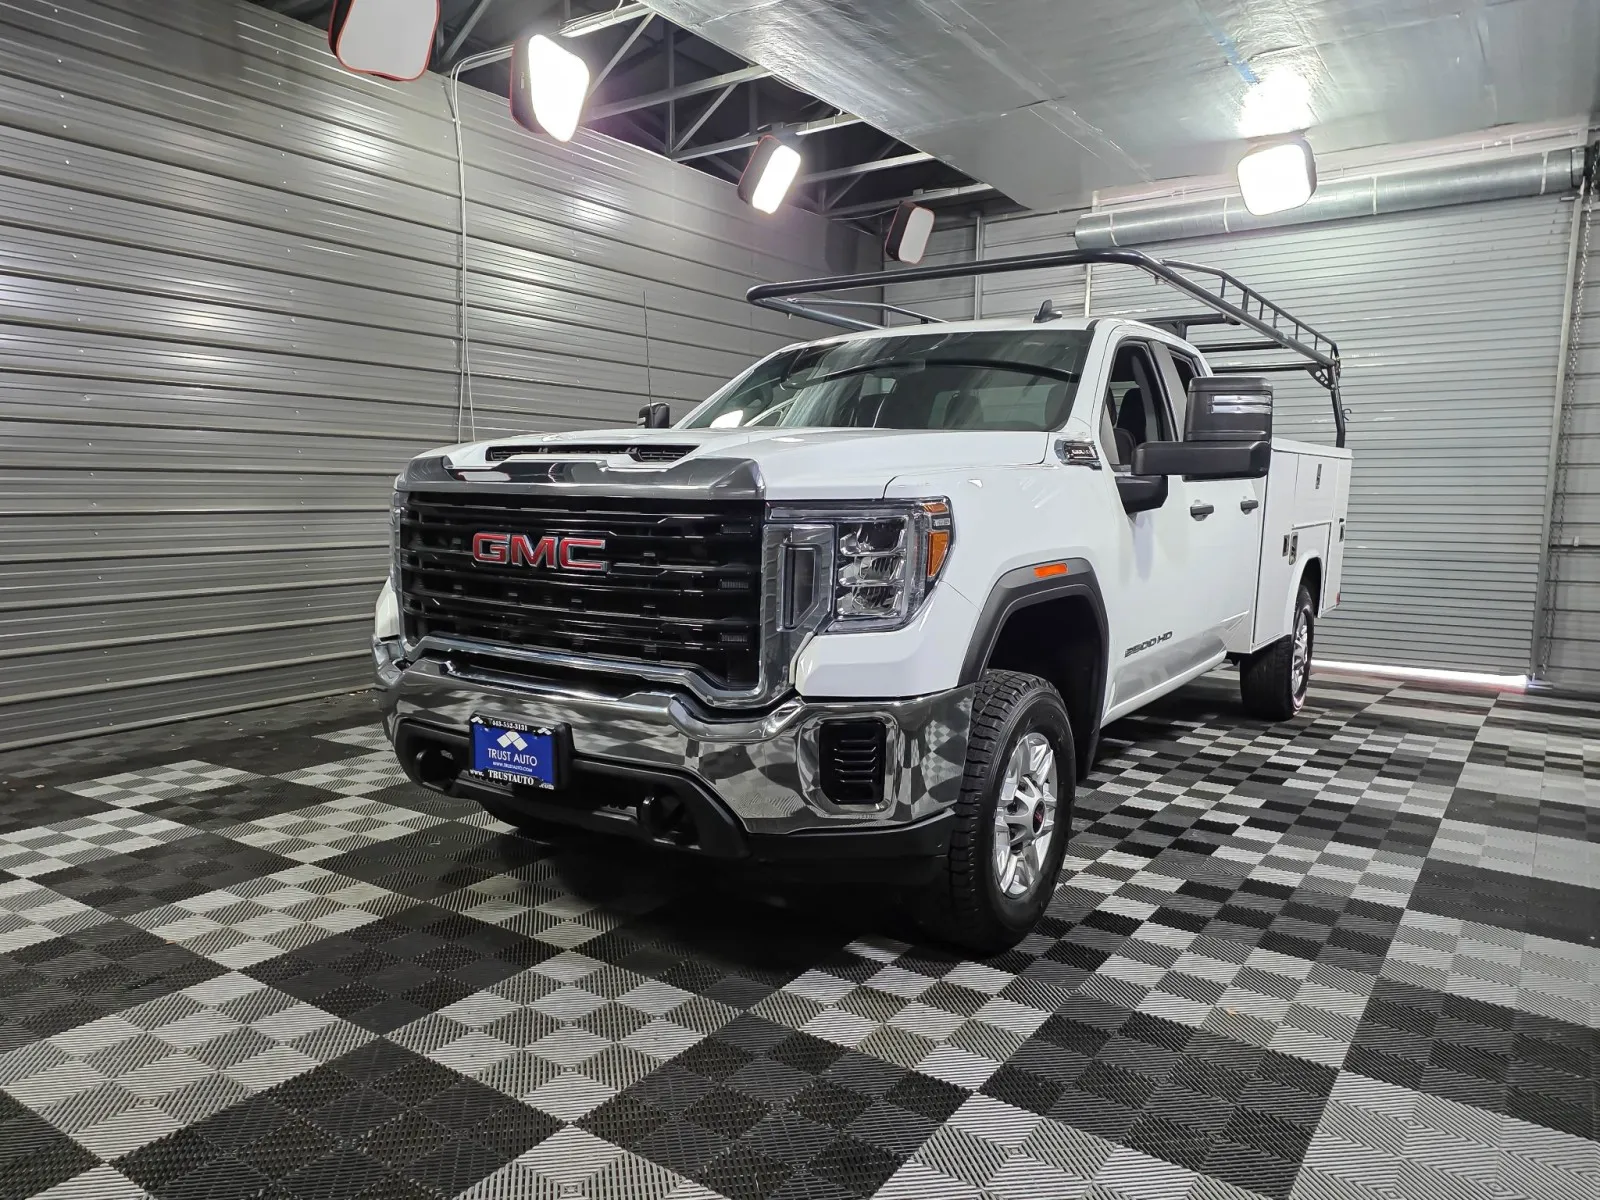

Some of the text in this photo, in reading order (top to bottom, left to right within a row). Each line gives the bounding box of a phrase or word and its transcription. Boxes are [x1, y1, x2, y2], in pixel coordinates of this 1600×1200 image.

[472, 532, 608, 571] GMC
[1124, 630, 1173, 658] 2500 HD
[488, 748, 538, 766] TRUST AUTO
[488, 769, 534, 785] TRUSTAUTO
